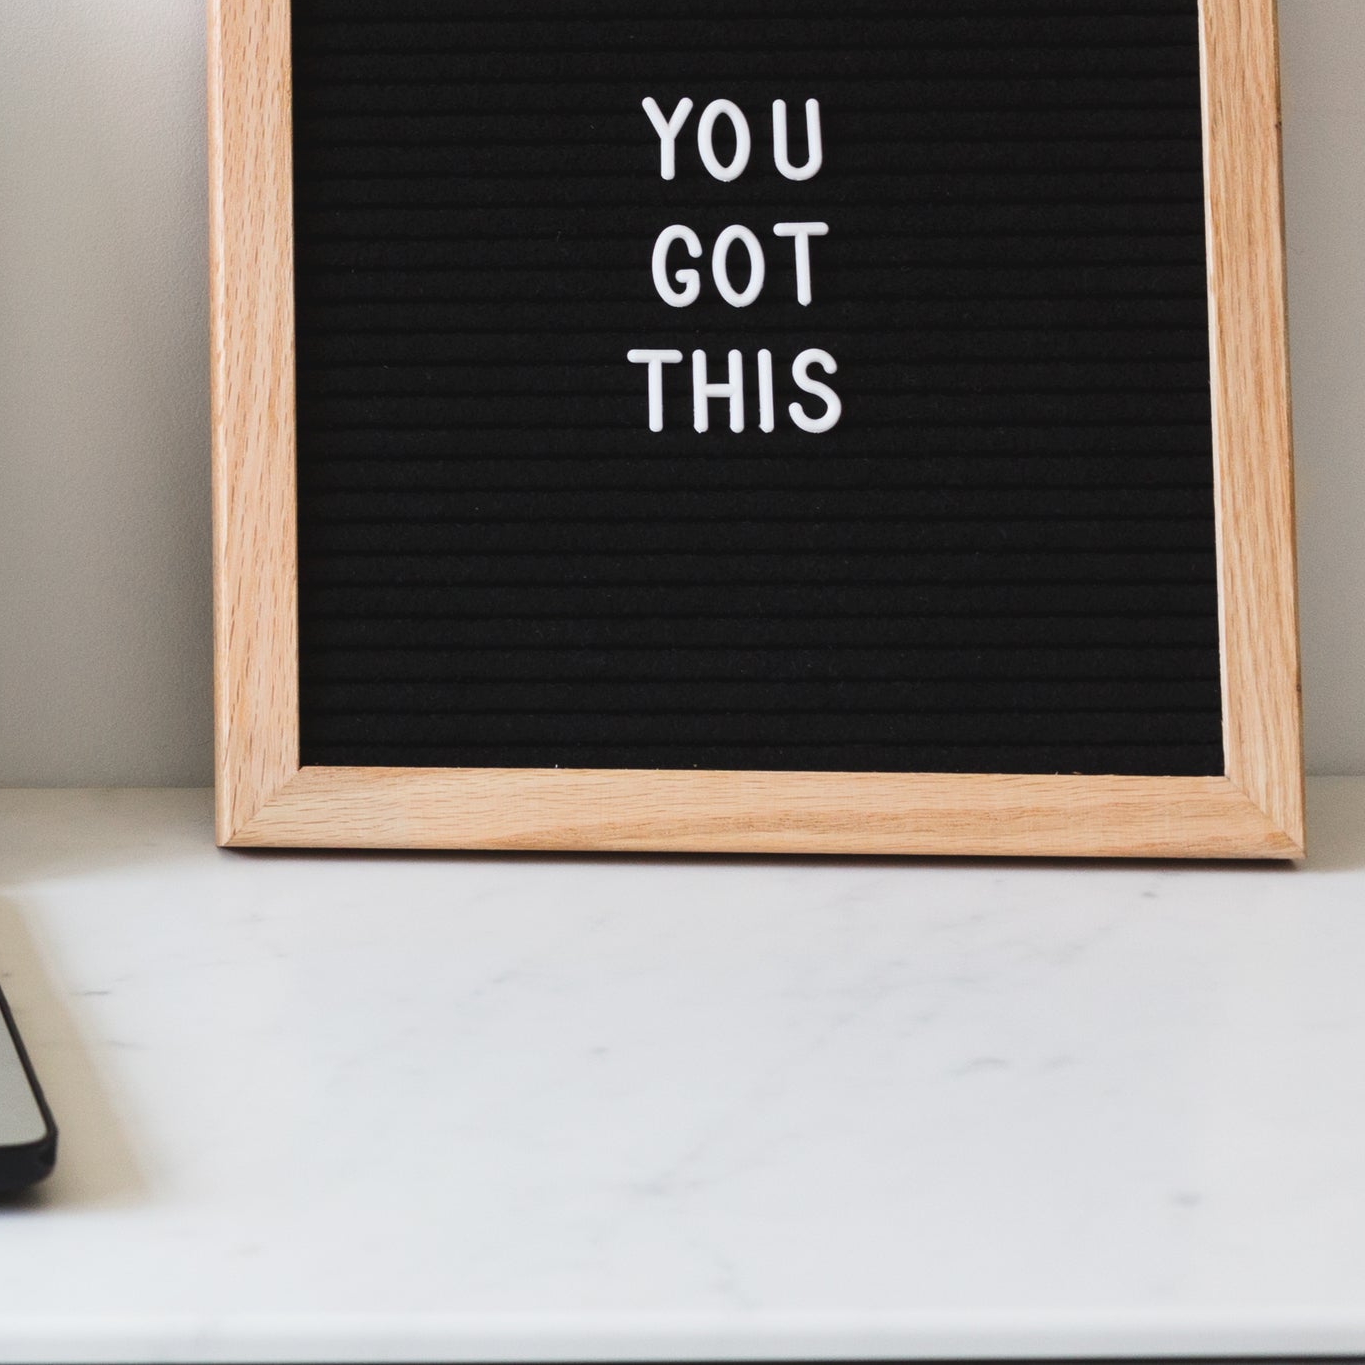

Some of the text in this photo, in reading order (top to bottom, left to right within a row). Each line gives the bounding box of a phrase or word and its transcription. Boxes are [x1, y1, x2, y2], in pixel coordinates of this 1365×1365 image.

[642, 97, 822, 182] YOU
[652, 222, 828, 307] GOT
[627, 349, 841, 433] THIS
